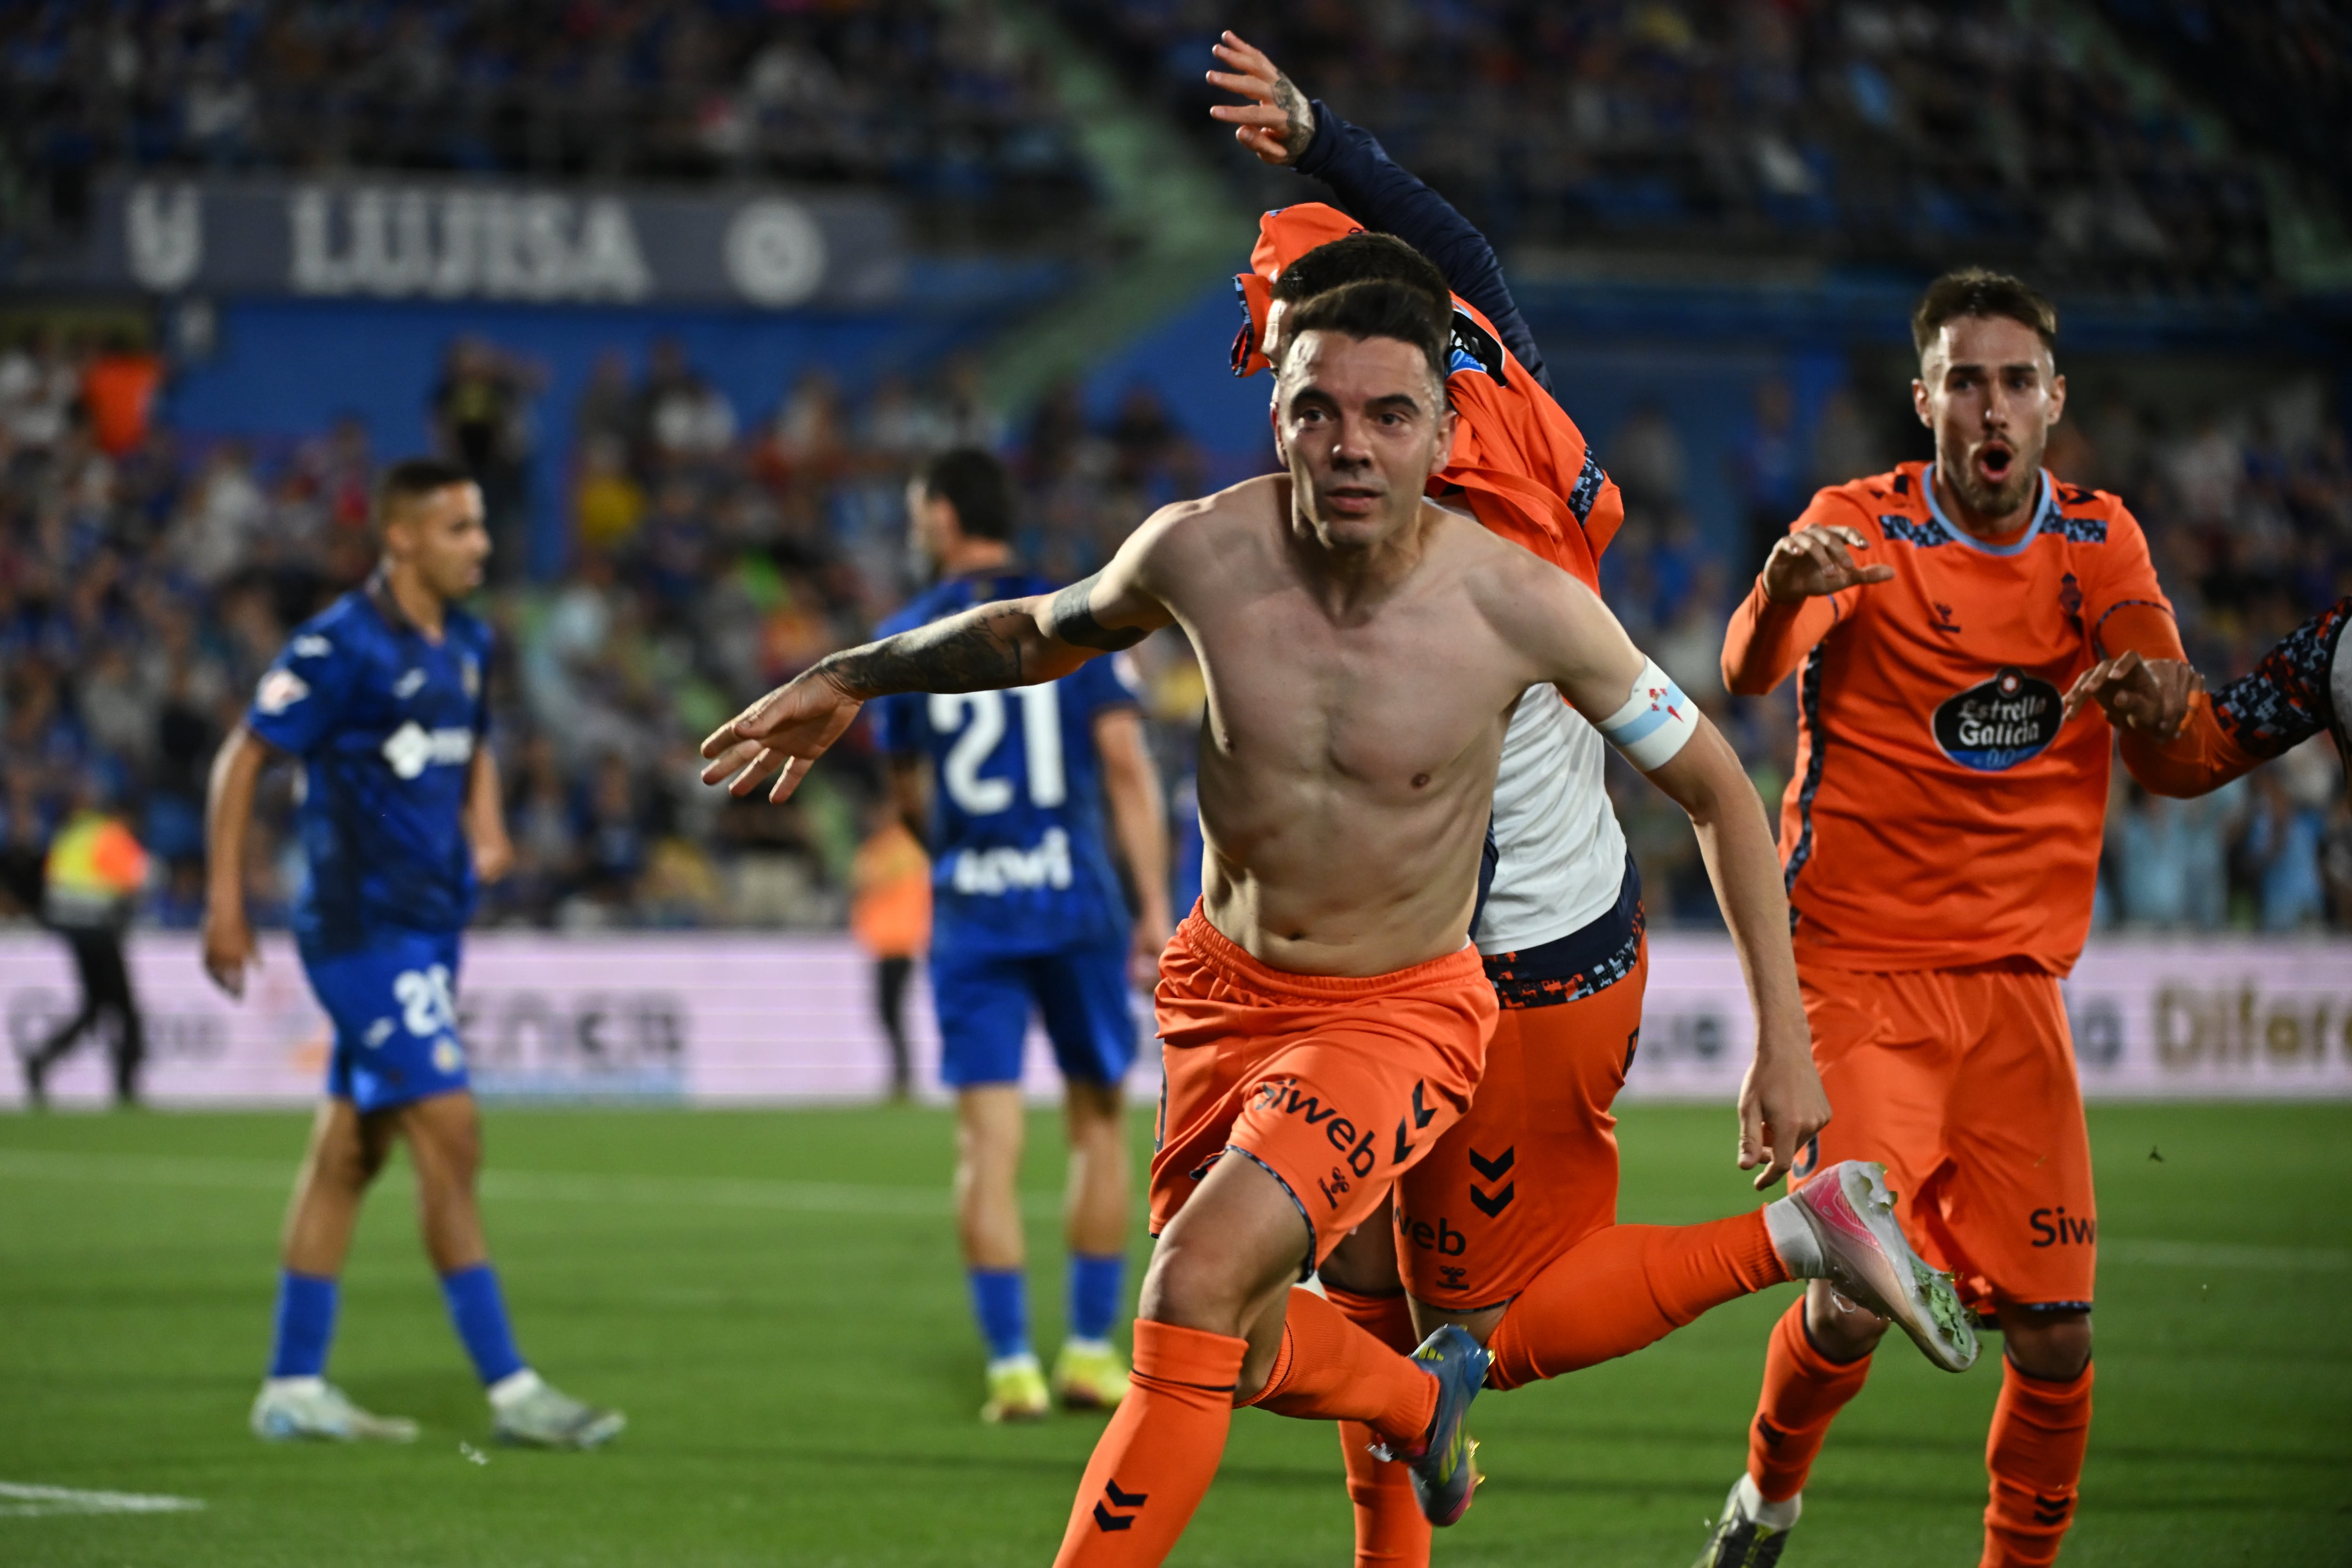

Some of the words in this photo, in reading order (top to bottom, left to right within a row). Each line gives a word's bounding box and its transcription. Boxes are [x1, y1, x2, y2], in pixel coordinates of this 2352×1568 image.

[1957, 695, 2046, 722] Estrella
[928, 680, 1067, 815] 21
[1959, 719, 2039, 747] Galicia
[1394, 1206, 1466, 1256] web
[2030, 1206, 2097, 1247] Siw
